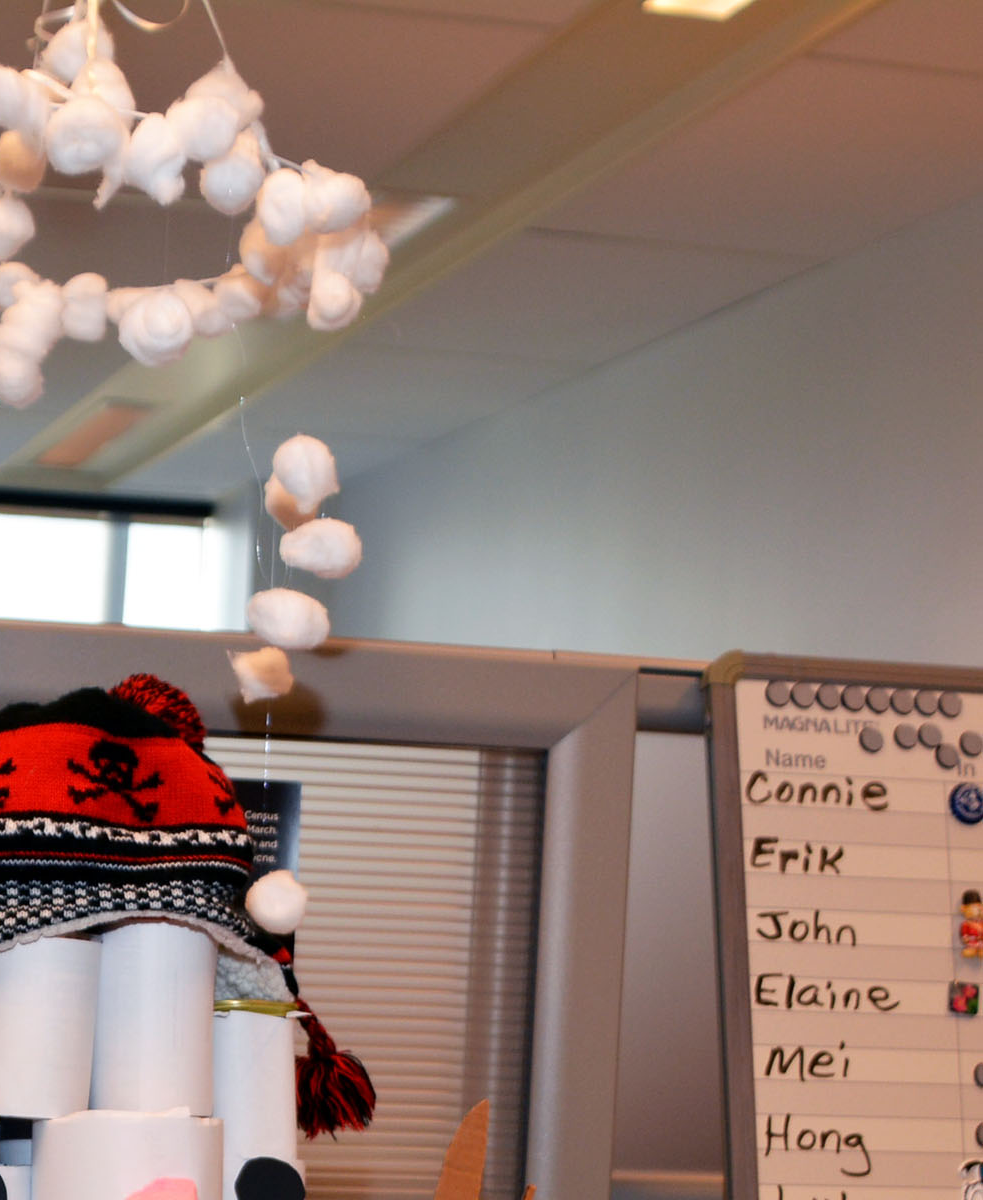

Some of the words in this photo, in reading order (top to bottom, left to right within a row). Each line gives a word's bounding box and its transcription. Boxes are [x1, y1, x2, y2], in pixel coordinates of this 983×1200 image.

[765, 749, 827, 769] Name
[746, 770, 889, 811] Connie
[750, 837, 844, 874] Erik
[756, 910, 857, 947] John
[755, 973, 899, 1012] Elaine
[764, 1041, 849, 1082] Mei
[765, 1113, 871, 1177] Hong
